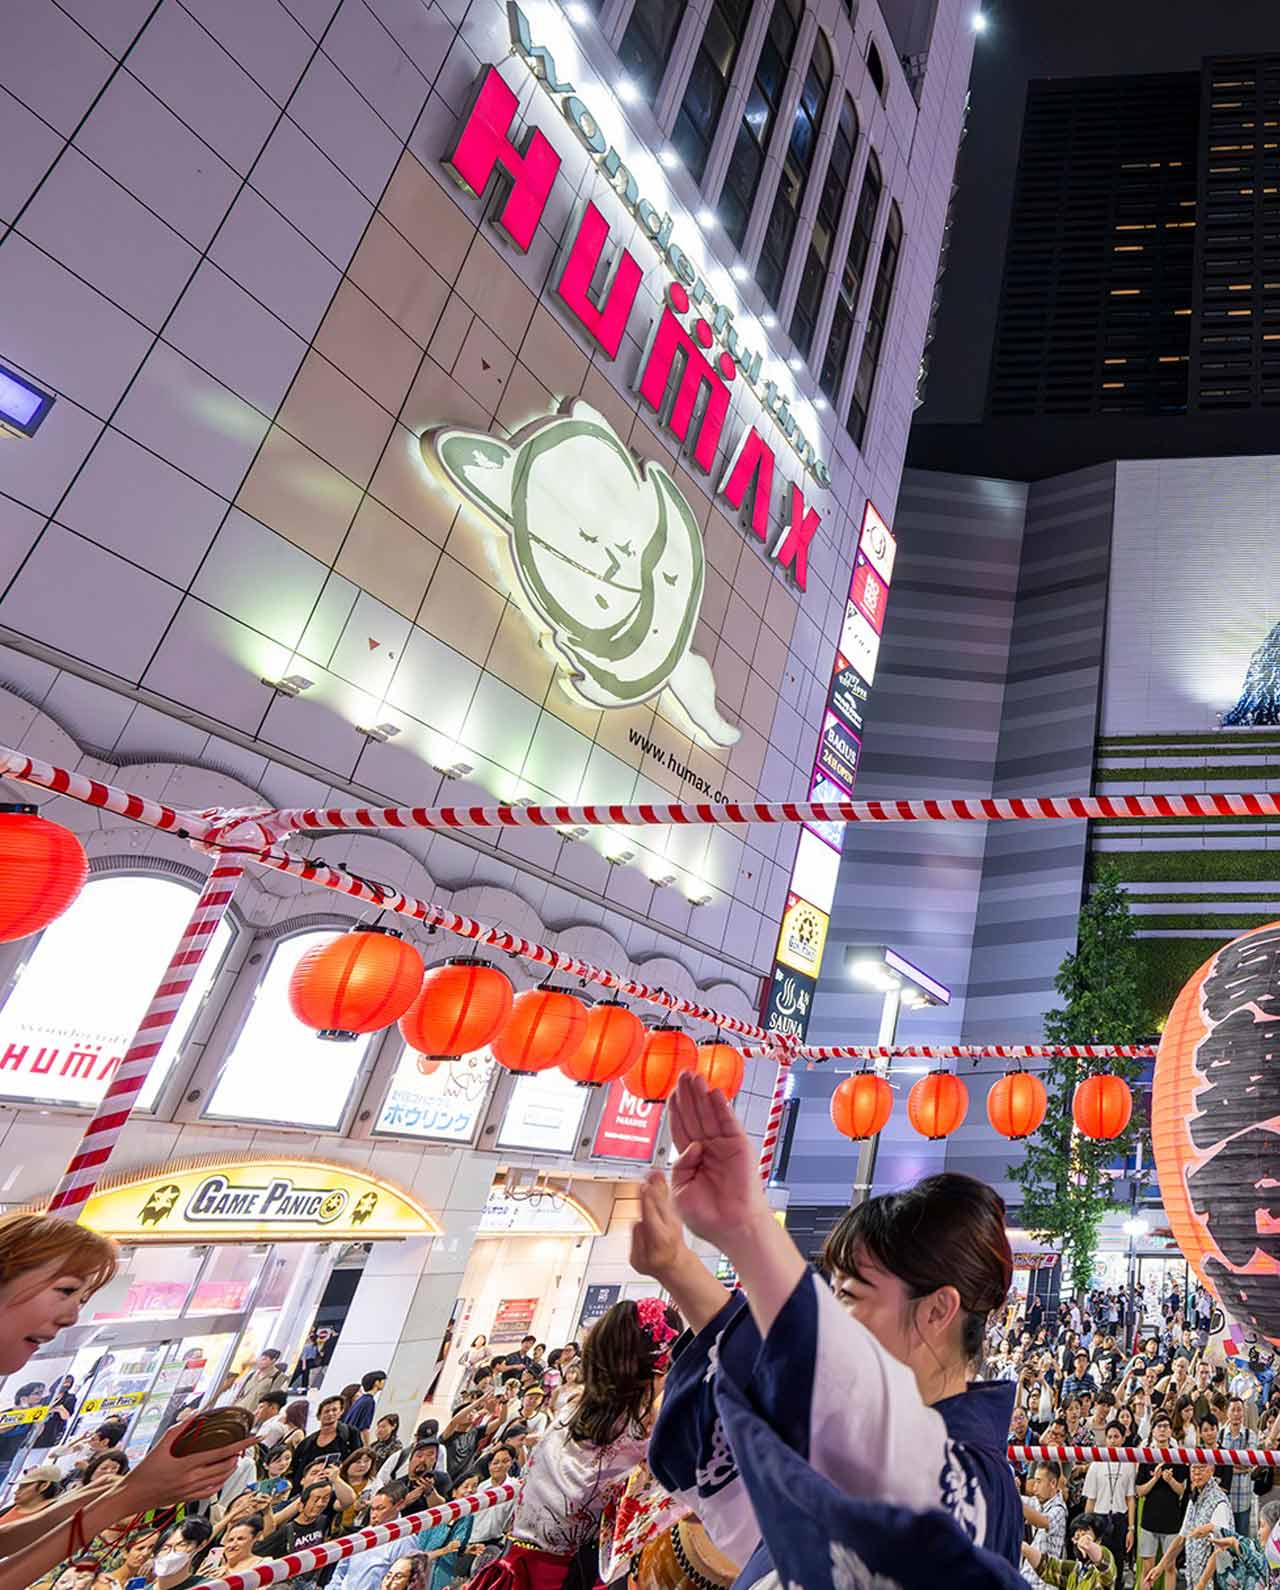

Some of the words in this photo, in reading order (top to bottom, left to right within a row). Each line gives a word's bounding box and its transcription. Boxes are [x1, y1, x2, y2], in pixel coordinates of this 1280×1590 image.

[441, 63, 822, 593] HUMAX
[827, 728, 857, 766] BAGUS
[769, 1011, 803, 1038] SAUNA
[192, 1180, 258, 1215] GAME
[258, 1183, 324, 1217] PANIC
